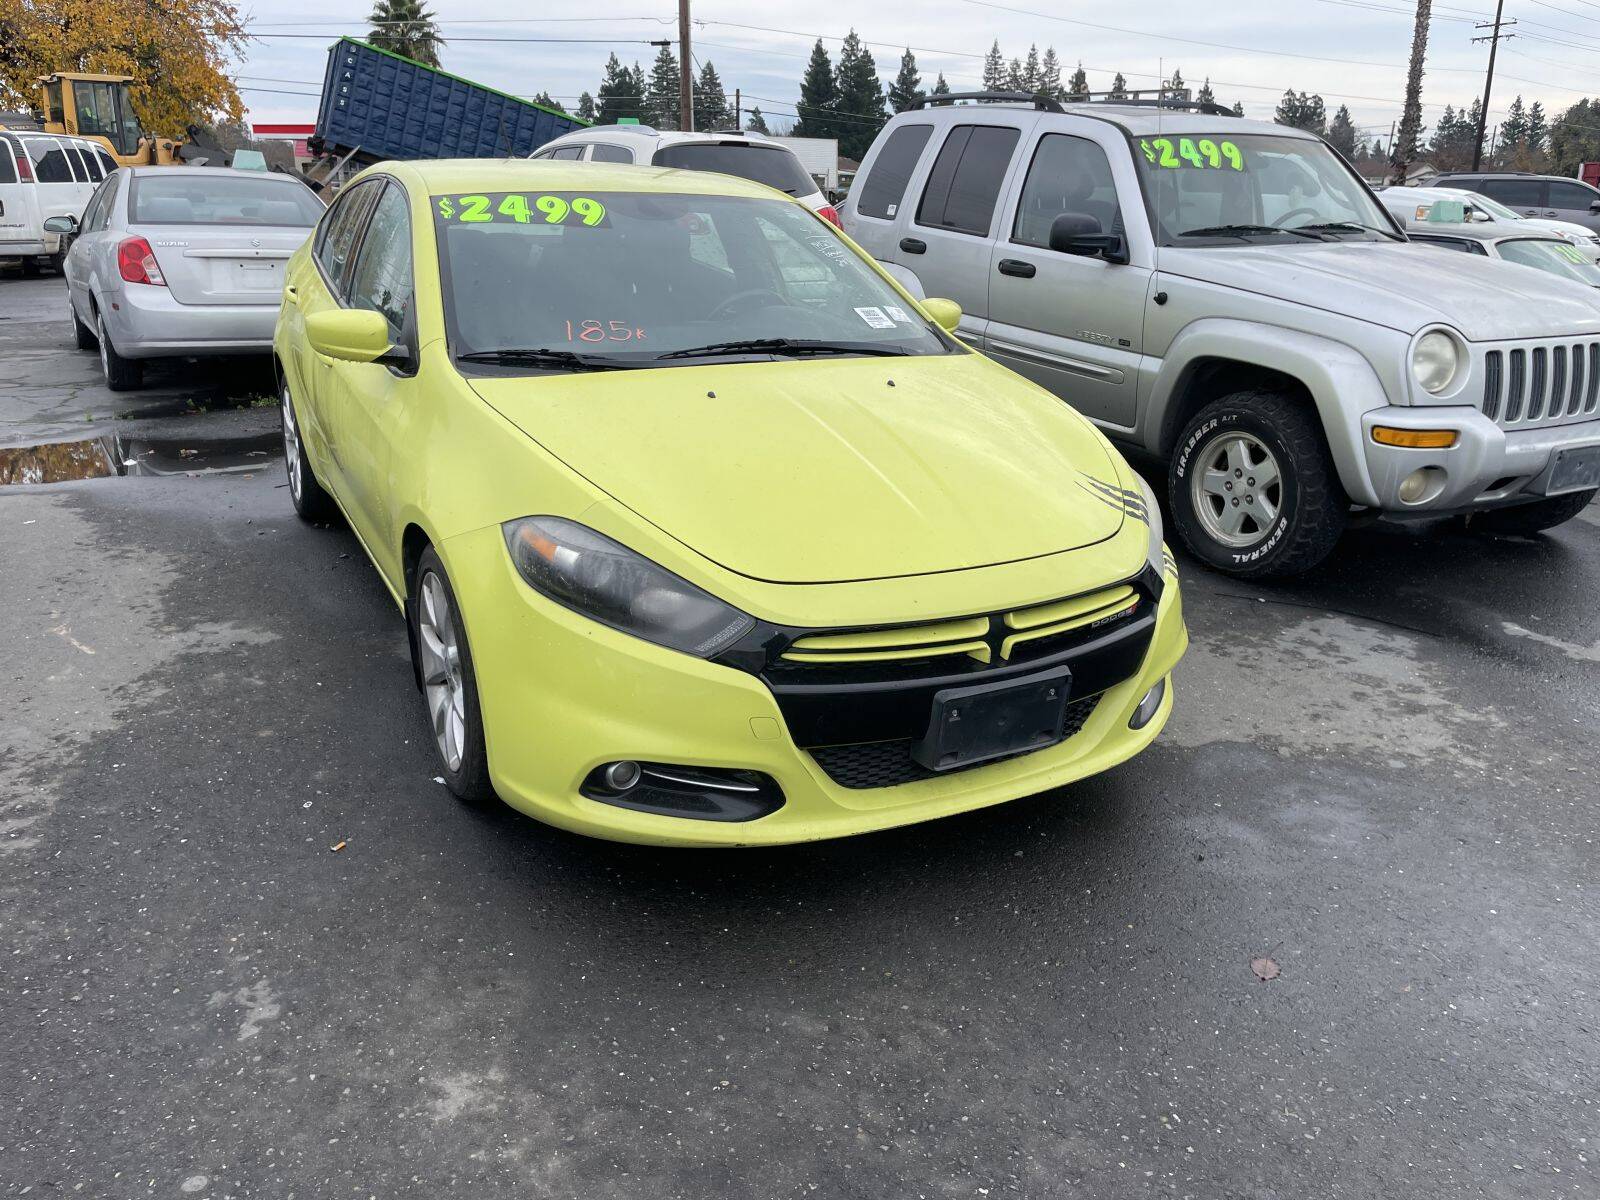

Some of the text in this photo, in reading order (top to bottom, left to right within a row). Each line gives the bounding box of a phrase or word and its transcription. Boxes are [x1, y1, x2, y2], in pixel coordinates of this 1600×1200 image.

[1141, 138, 1243, 171] $2499
[438, 195, 606, 227] $2499
[1176, 414, 1238, 478] GRABBER A/T
[1232, 516, 1288, 563] GENERAL
[1091, 606, 1133, 629] DODGE
